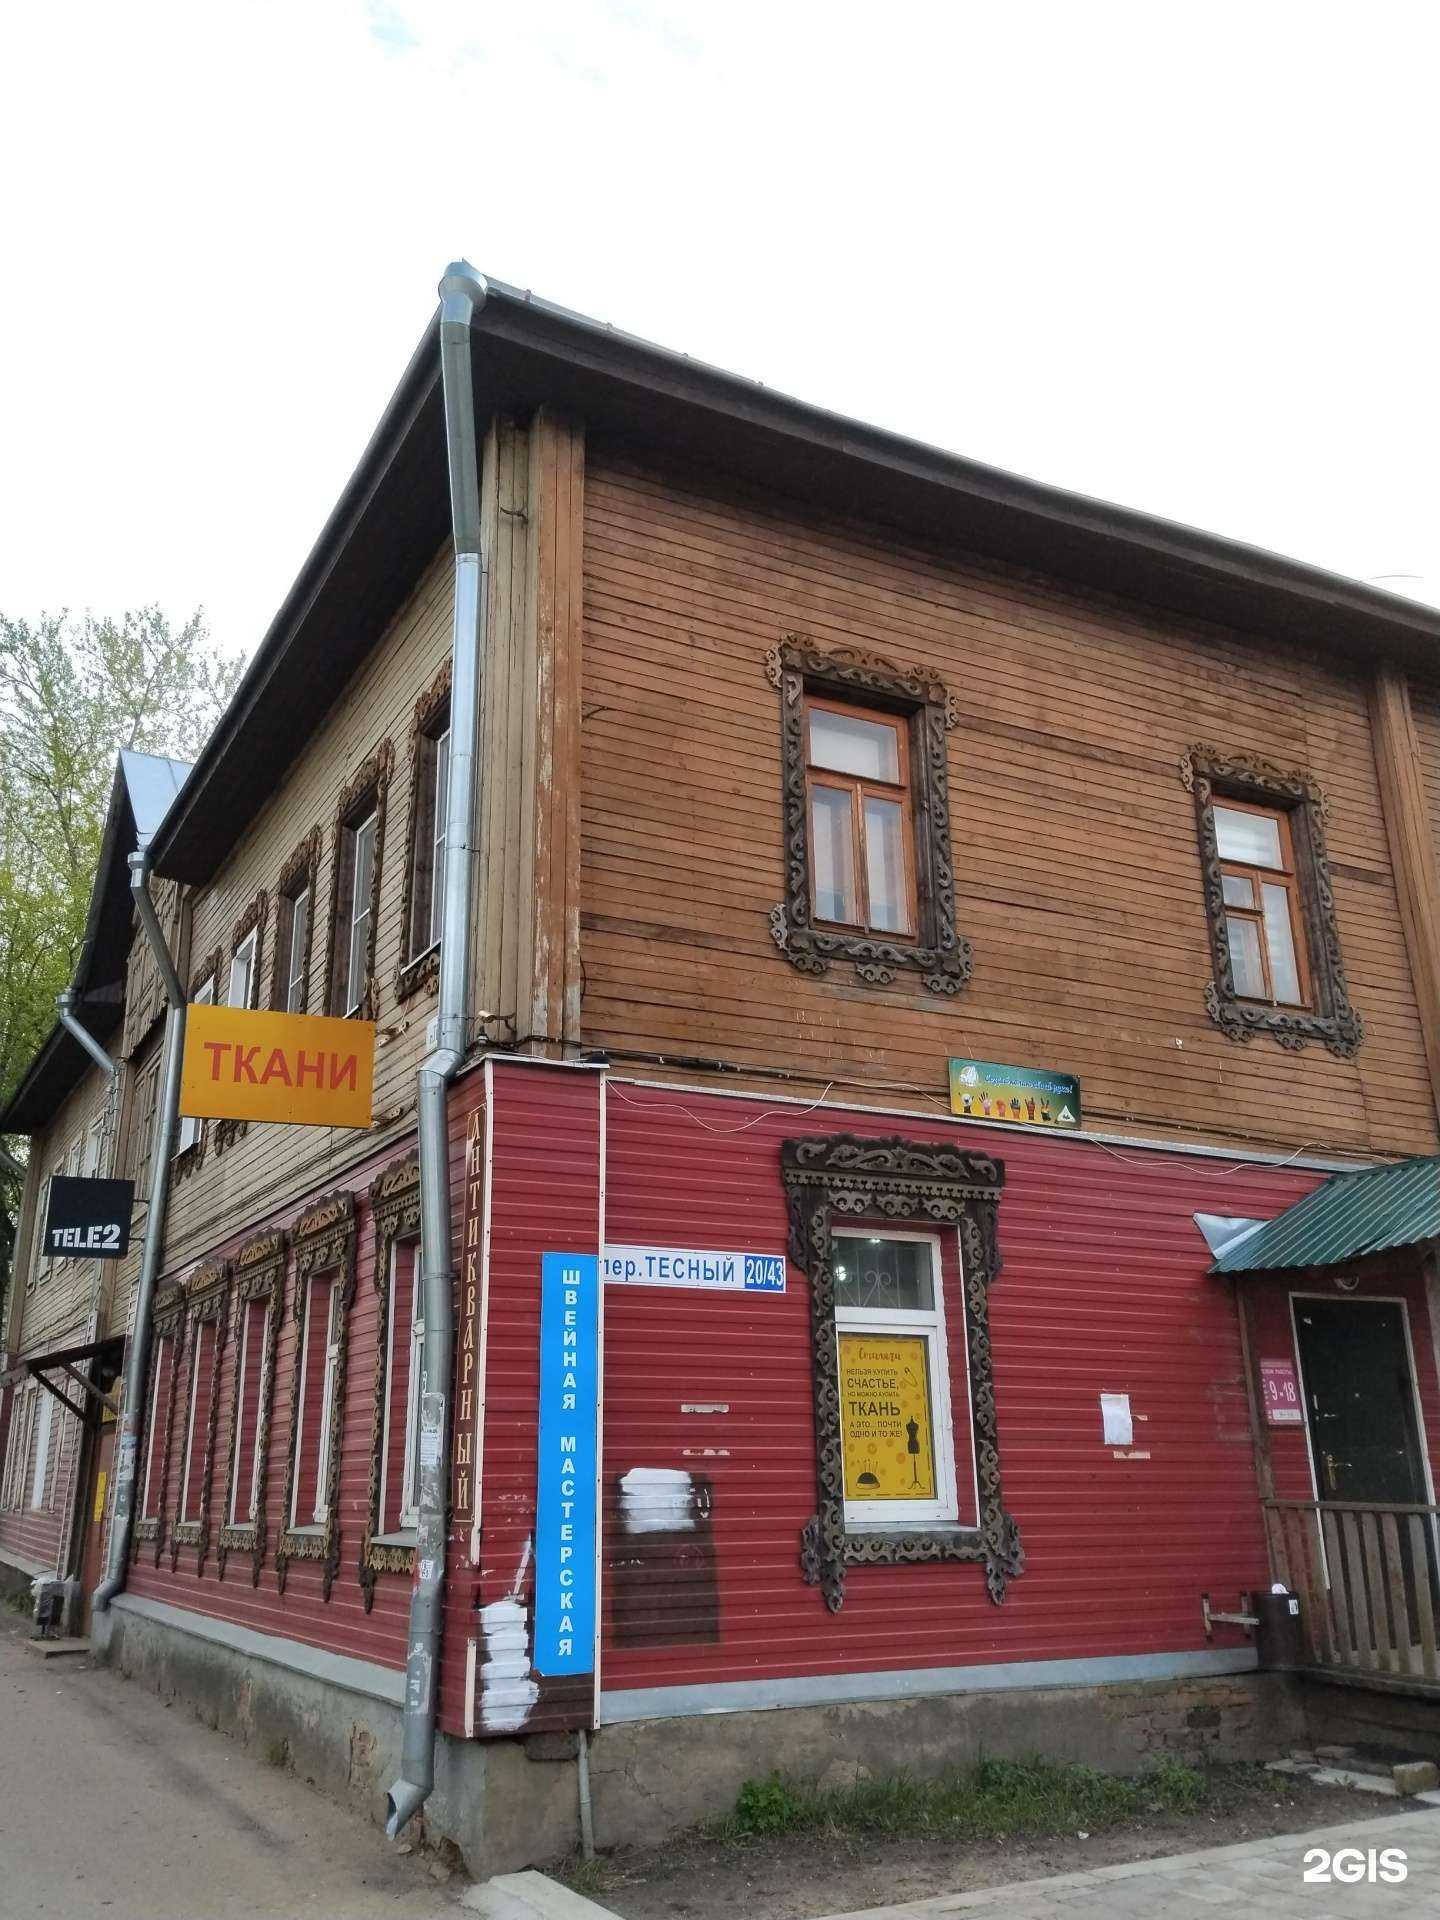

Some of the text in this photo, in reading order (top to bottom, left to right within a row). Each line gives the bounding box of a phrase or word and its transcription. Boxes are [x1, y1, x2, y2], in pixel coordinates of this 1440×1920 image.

[204, 1041, 357, 1091] ТКАНИ
[52, 1224, 121, 1249] TELE2
[746, 1259, 784, 1286] 20/43
[457, 1112, 481, 1510] АНТИКВАРНЫЙ
[847, 1378, 899, 1390] СЧАСТЬЕ,
[848, 1401, 901, 1416] ТКАНЬ
[558, 1269, 581, 1656] ШВЕЙНАЯ МАСТЕРСКАЯ
